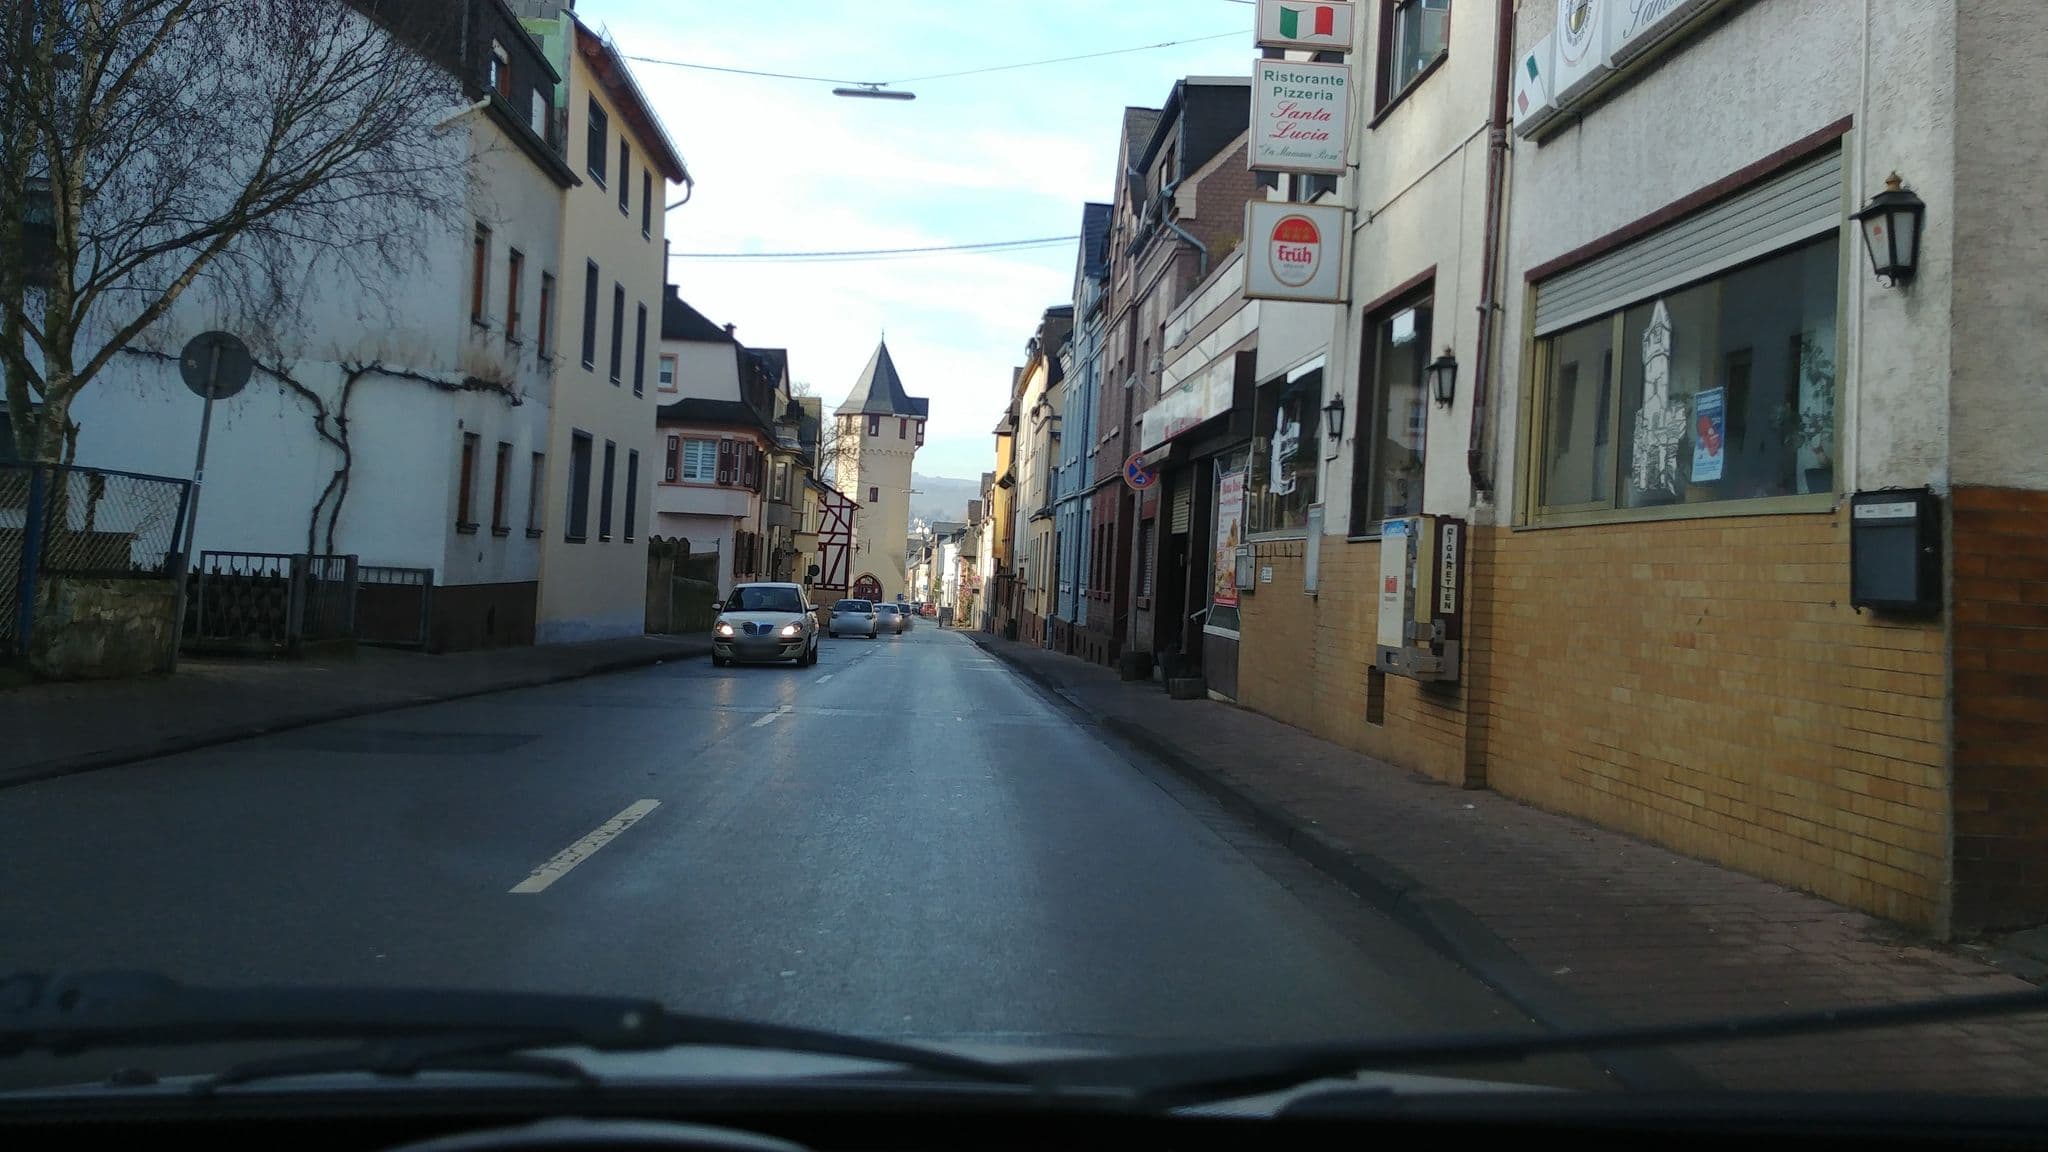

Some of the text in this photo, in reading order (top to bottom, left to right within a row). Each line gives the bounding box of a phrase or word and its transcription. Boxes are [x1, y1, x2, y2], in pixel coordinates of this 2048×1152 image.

[1264, 70, 1344, 86] Ristorante
[1273, 86, 1333, 101] Pizzeria
[1270, 100, 1332, 122] Santa
[1268, 121, 1329, 141] Lucia
[1278, 245, 1312, 264] Früh
